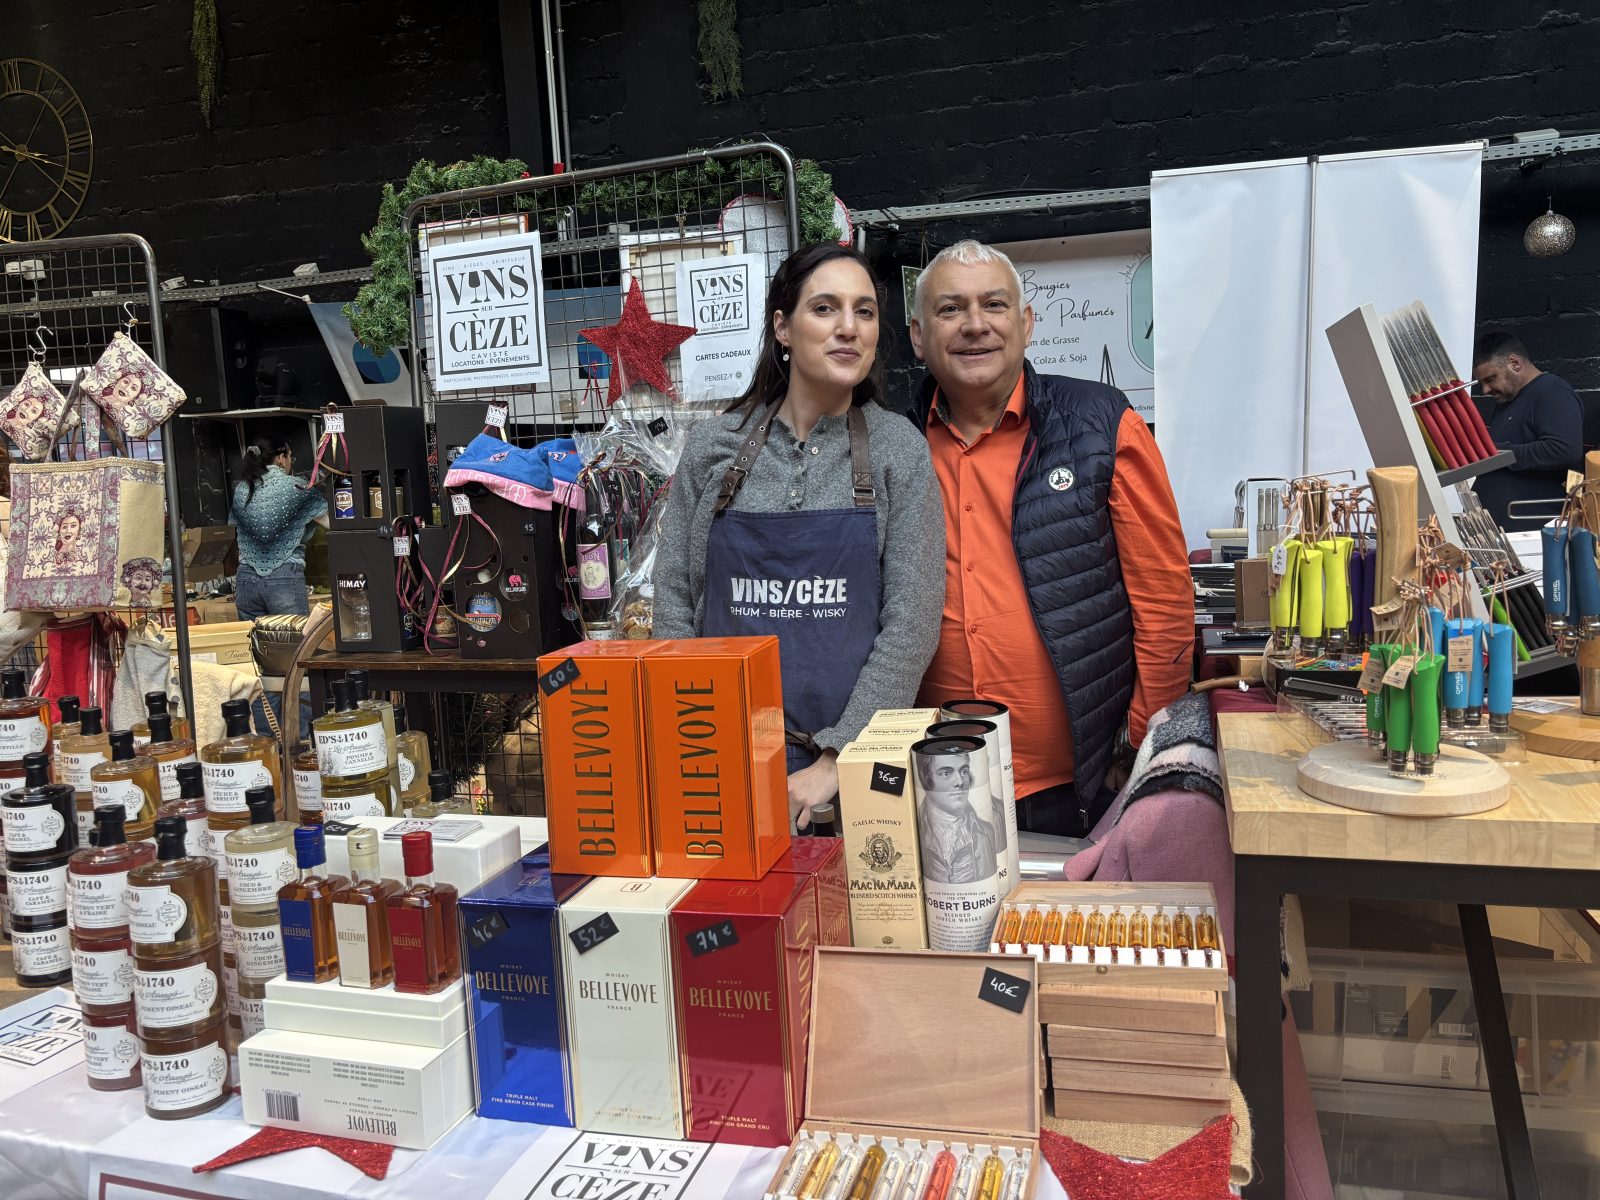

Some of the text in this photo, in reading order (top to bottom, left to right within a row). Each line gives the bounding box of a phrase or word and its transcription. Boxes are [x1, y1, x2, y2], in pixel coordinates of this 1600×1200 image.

[443, 265, 529, 306] VINS
[696, 274, 743, 297] VINS
[1020, 269, 1070, 304] Bougies
[699, 301, 743, 324] CÈZE
[1046, 298, 1115, 327] Parfumés
[449, 312, 529, 353] CÈZE
[1040, 336, 1080, 346] de Grasse
[451, 357, 484, 367] LOCATIONS
[695, 349, 752, 362] CARTES CADEAUX
[1033, 355, 1057, 365] Colza
[1070, 353, 1088, 363] Soja
[338, 579, 366, 588] HIMAY
[730, 575, 847, 605] VINS/CÈZE
[730, 606, 847, 618] RHUM BIÈRE WISKY
[344, 731, 368, 743] 1740
[211, 768, 235, 778] 1740
[570, 680, 617, 856] BELLEVOYE
[674, 679, 725, 859] BELLEVOYE
[329, 802, 351, 811] 1740
[852, 819, 876, 827] GAELIC
[234, 858, 258, 868] 1740
[24, 874, 49, 885] 1740
[77, 880, 102, 890] 1740
[924, 893, 960, 911] ROBERT
[962, 894, 996, 911] BURNS
[31, 934, 57, 945] 1740
[248, 930, 275, 942] 1740
[146, 976, 175, 988] 1740
[476, 971, 550, 996] BELLEVOYE
[990, 976, 1020, 998] 40€
[579, 980, 659, 1004] BELLEVOYE
[689, 986, 773, 1011] BELLEVOYE
[159, 1058, 189, 1071] 1740
[153, 1081, 208, 1096] PIMENT OISEAU
[504, 1097, 521, 1105] GRAIN
[536, 1100, 555, 1108] FINISH
[505, 1092, 524, 1100] TRIPLE
[347, 1114, 397, 1137] BELLEVOYE
[582, 1141, 695, 1172] VINS
[551, 1171, 671, 1200] CÈZE
